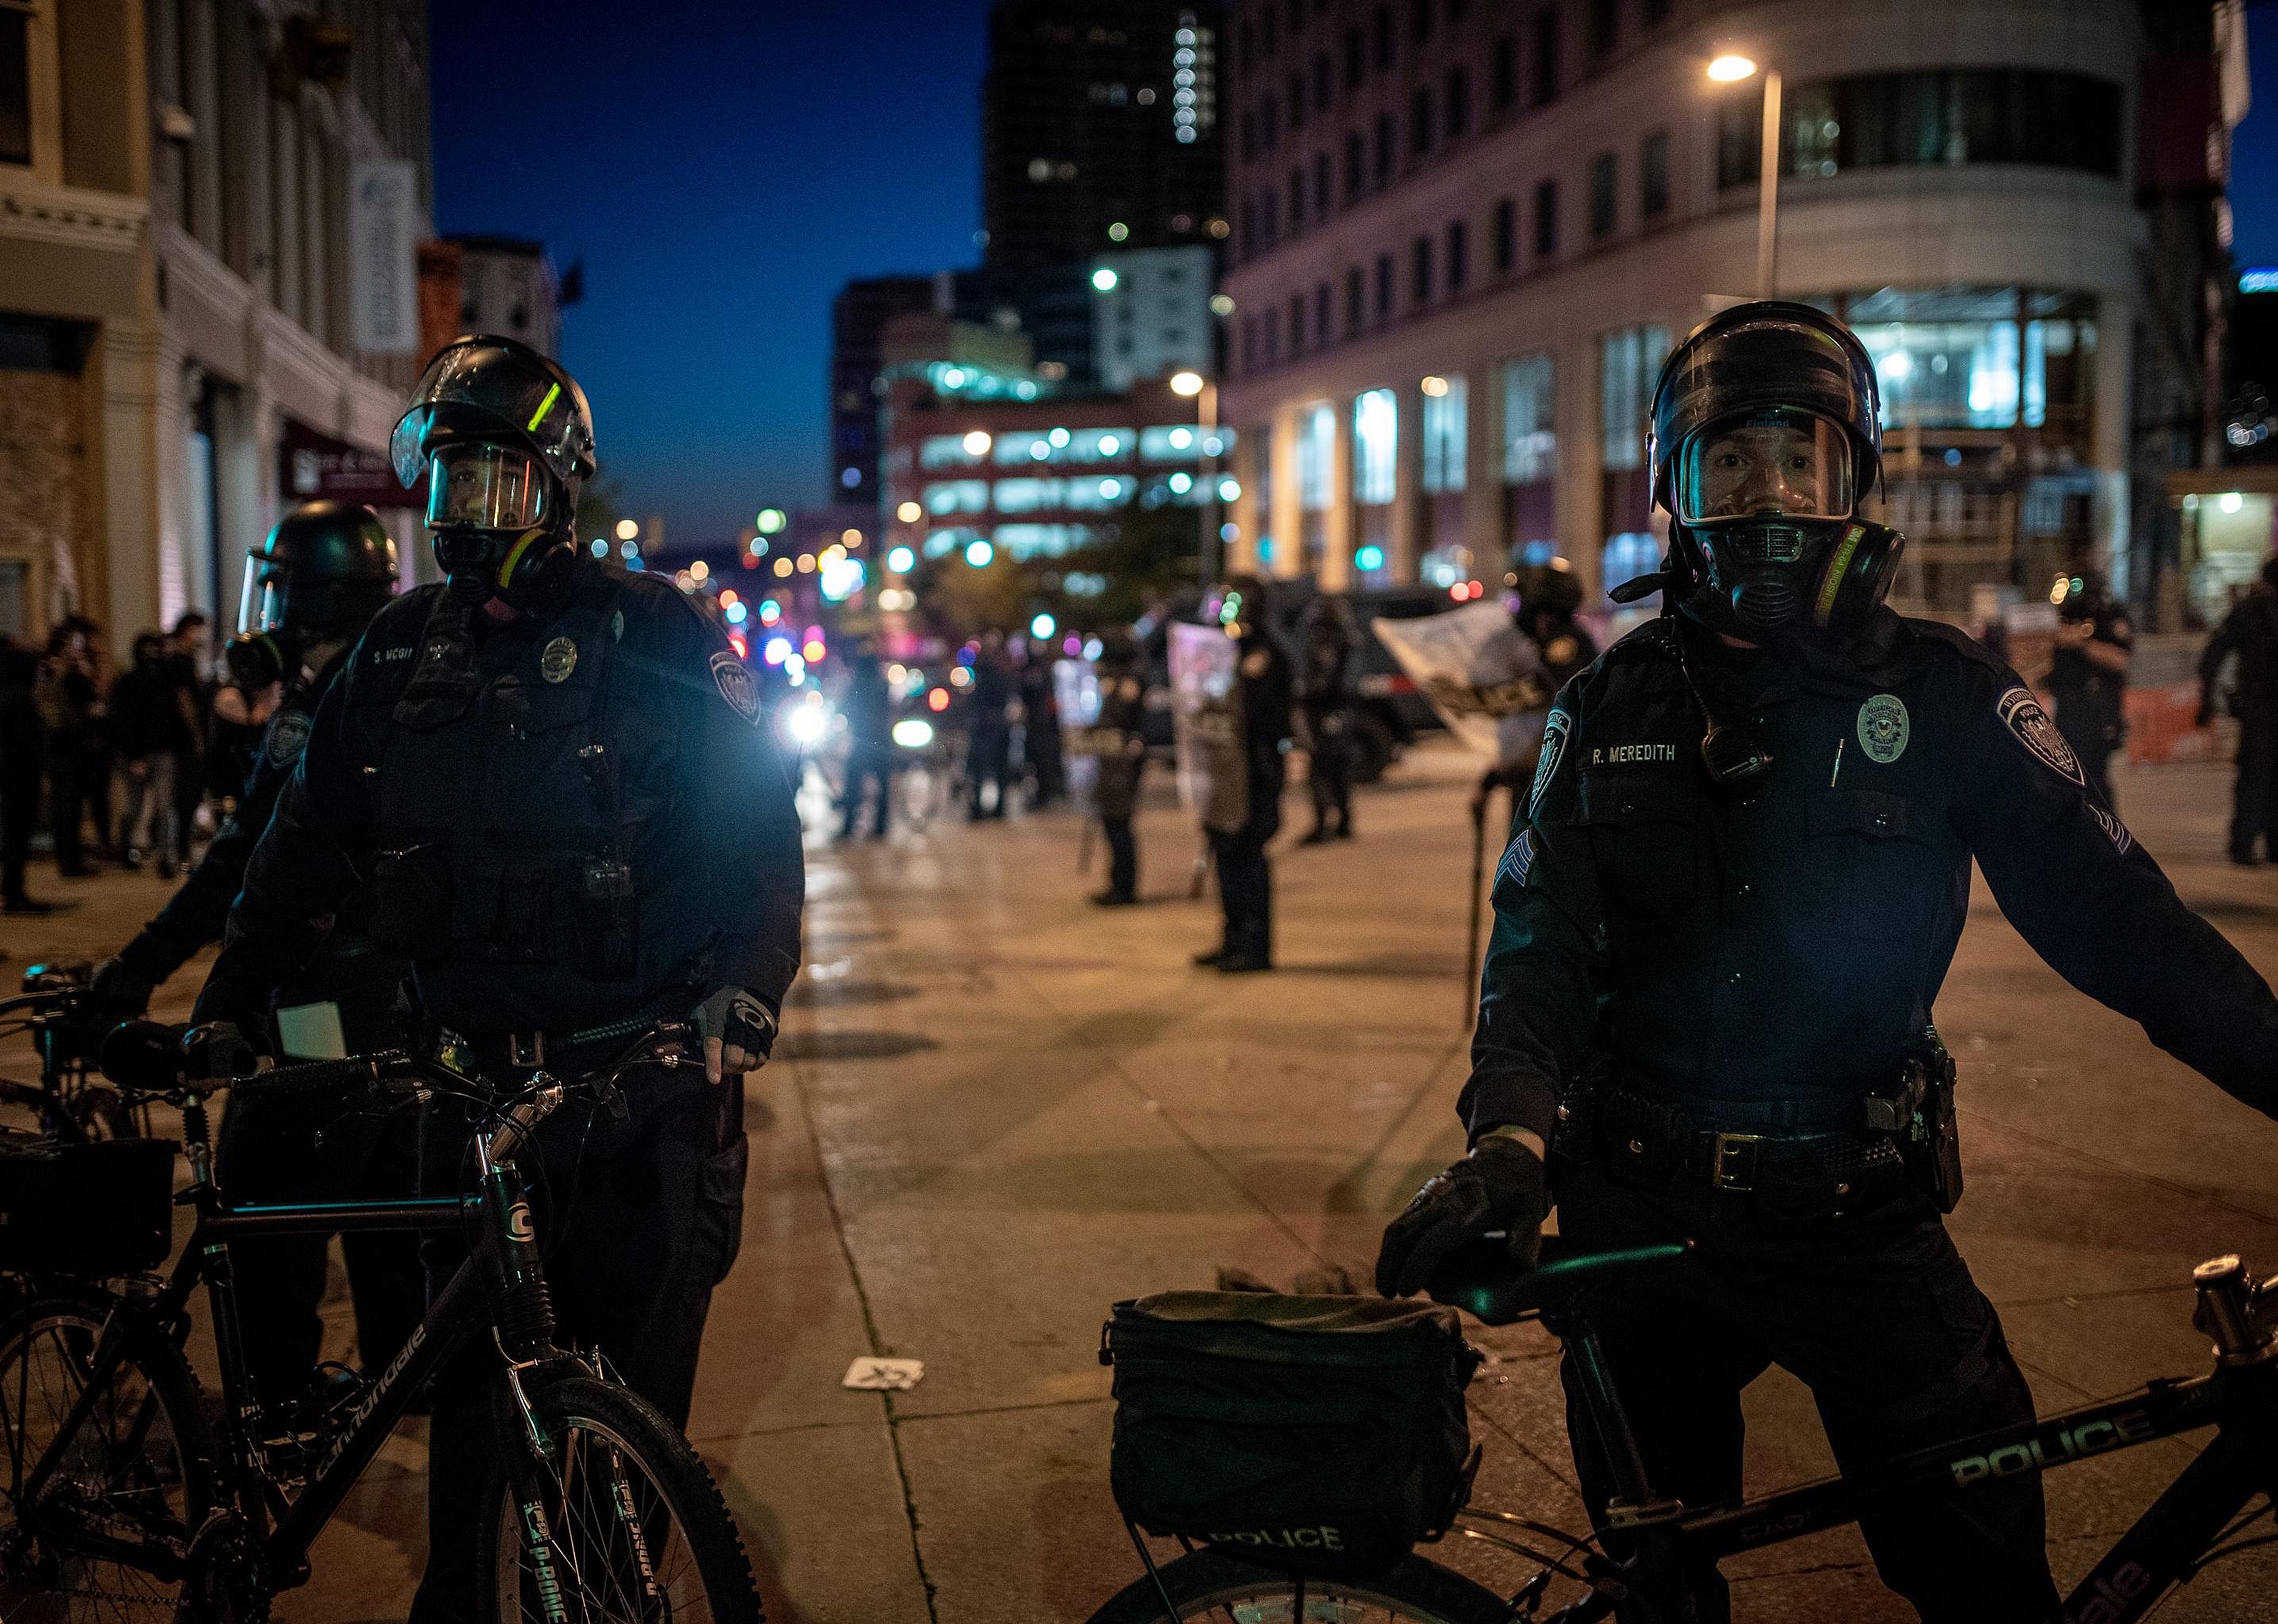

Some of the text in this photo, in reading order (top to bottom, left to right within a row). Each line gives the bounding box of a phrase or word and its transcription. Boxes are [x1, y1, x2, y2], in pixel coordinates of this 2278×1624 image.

[1593, 745, 1675, 766] R. MEREDITH
[316, 1323, 428, 1482] cannondale
[1950, 1411, 2156, 1488] POLICE
[1210, 1524, 1346, 1552] POLICE
